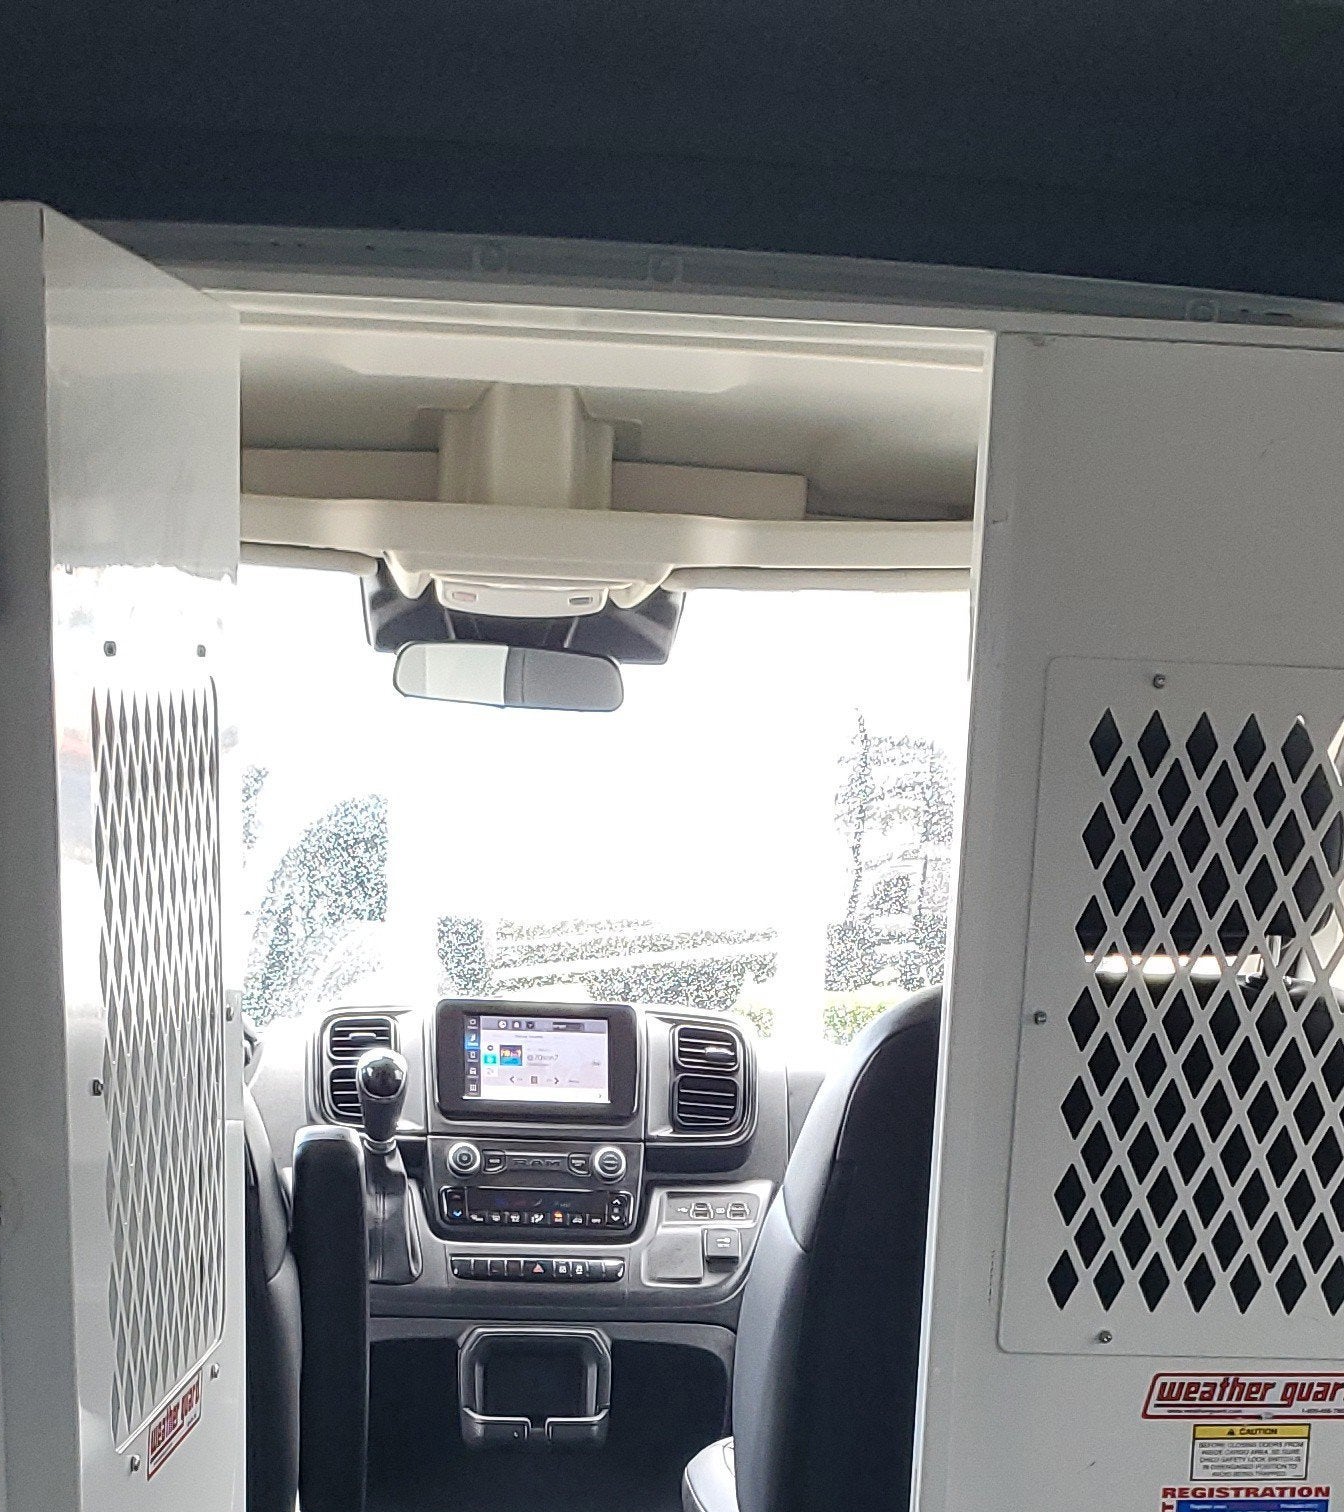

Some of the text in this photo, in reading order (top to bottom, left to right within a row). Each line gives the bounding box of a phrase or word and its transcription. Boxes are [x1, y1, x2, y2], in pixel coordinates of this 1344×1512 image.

[512, 1158, 560, 1167] RAM
[1156, 1377, 1276, 1402] weather
[1162, 1486, 1331, 1498] REGISTRATION
